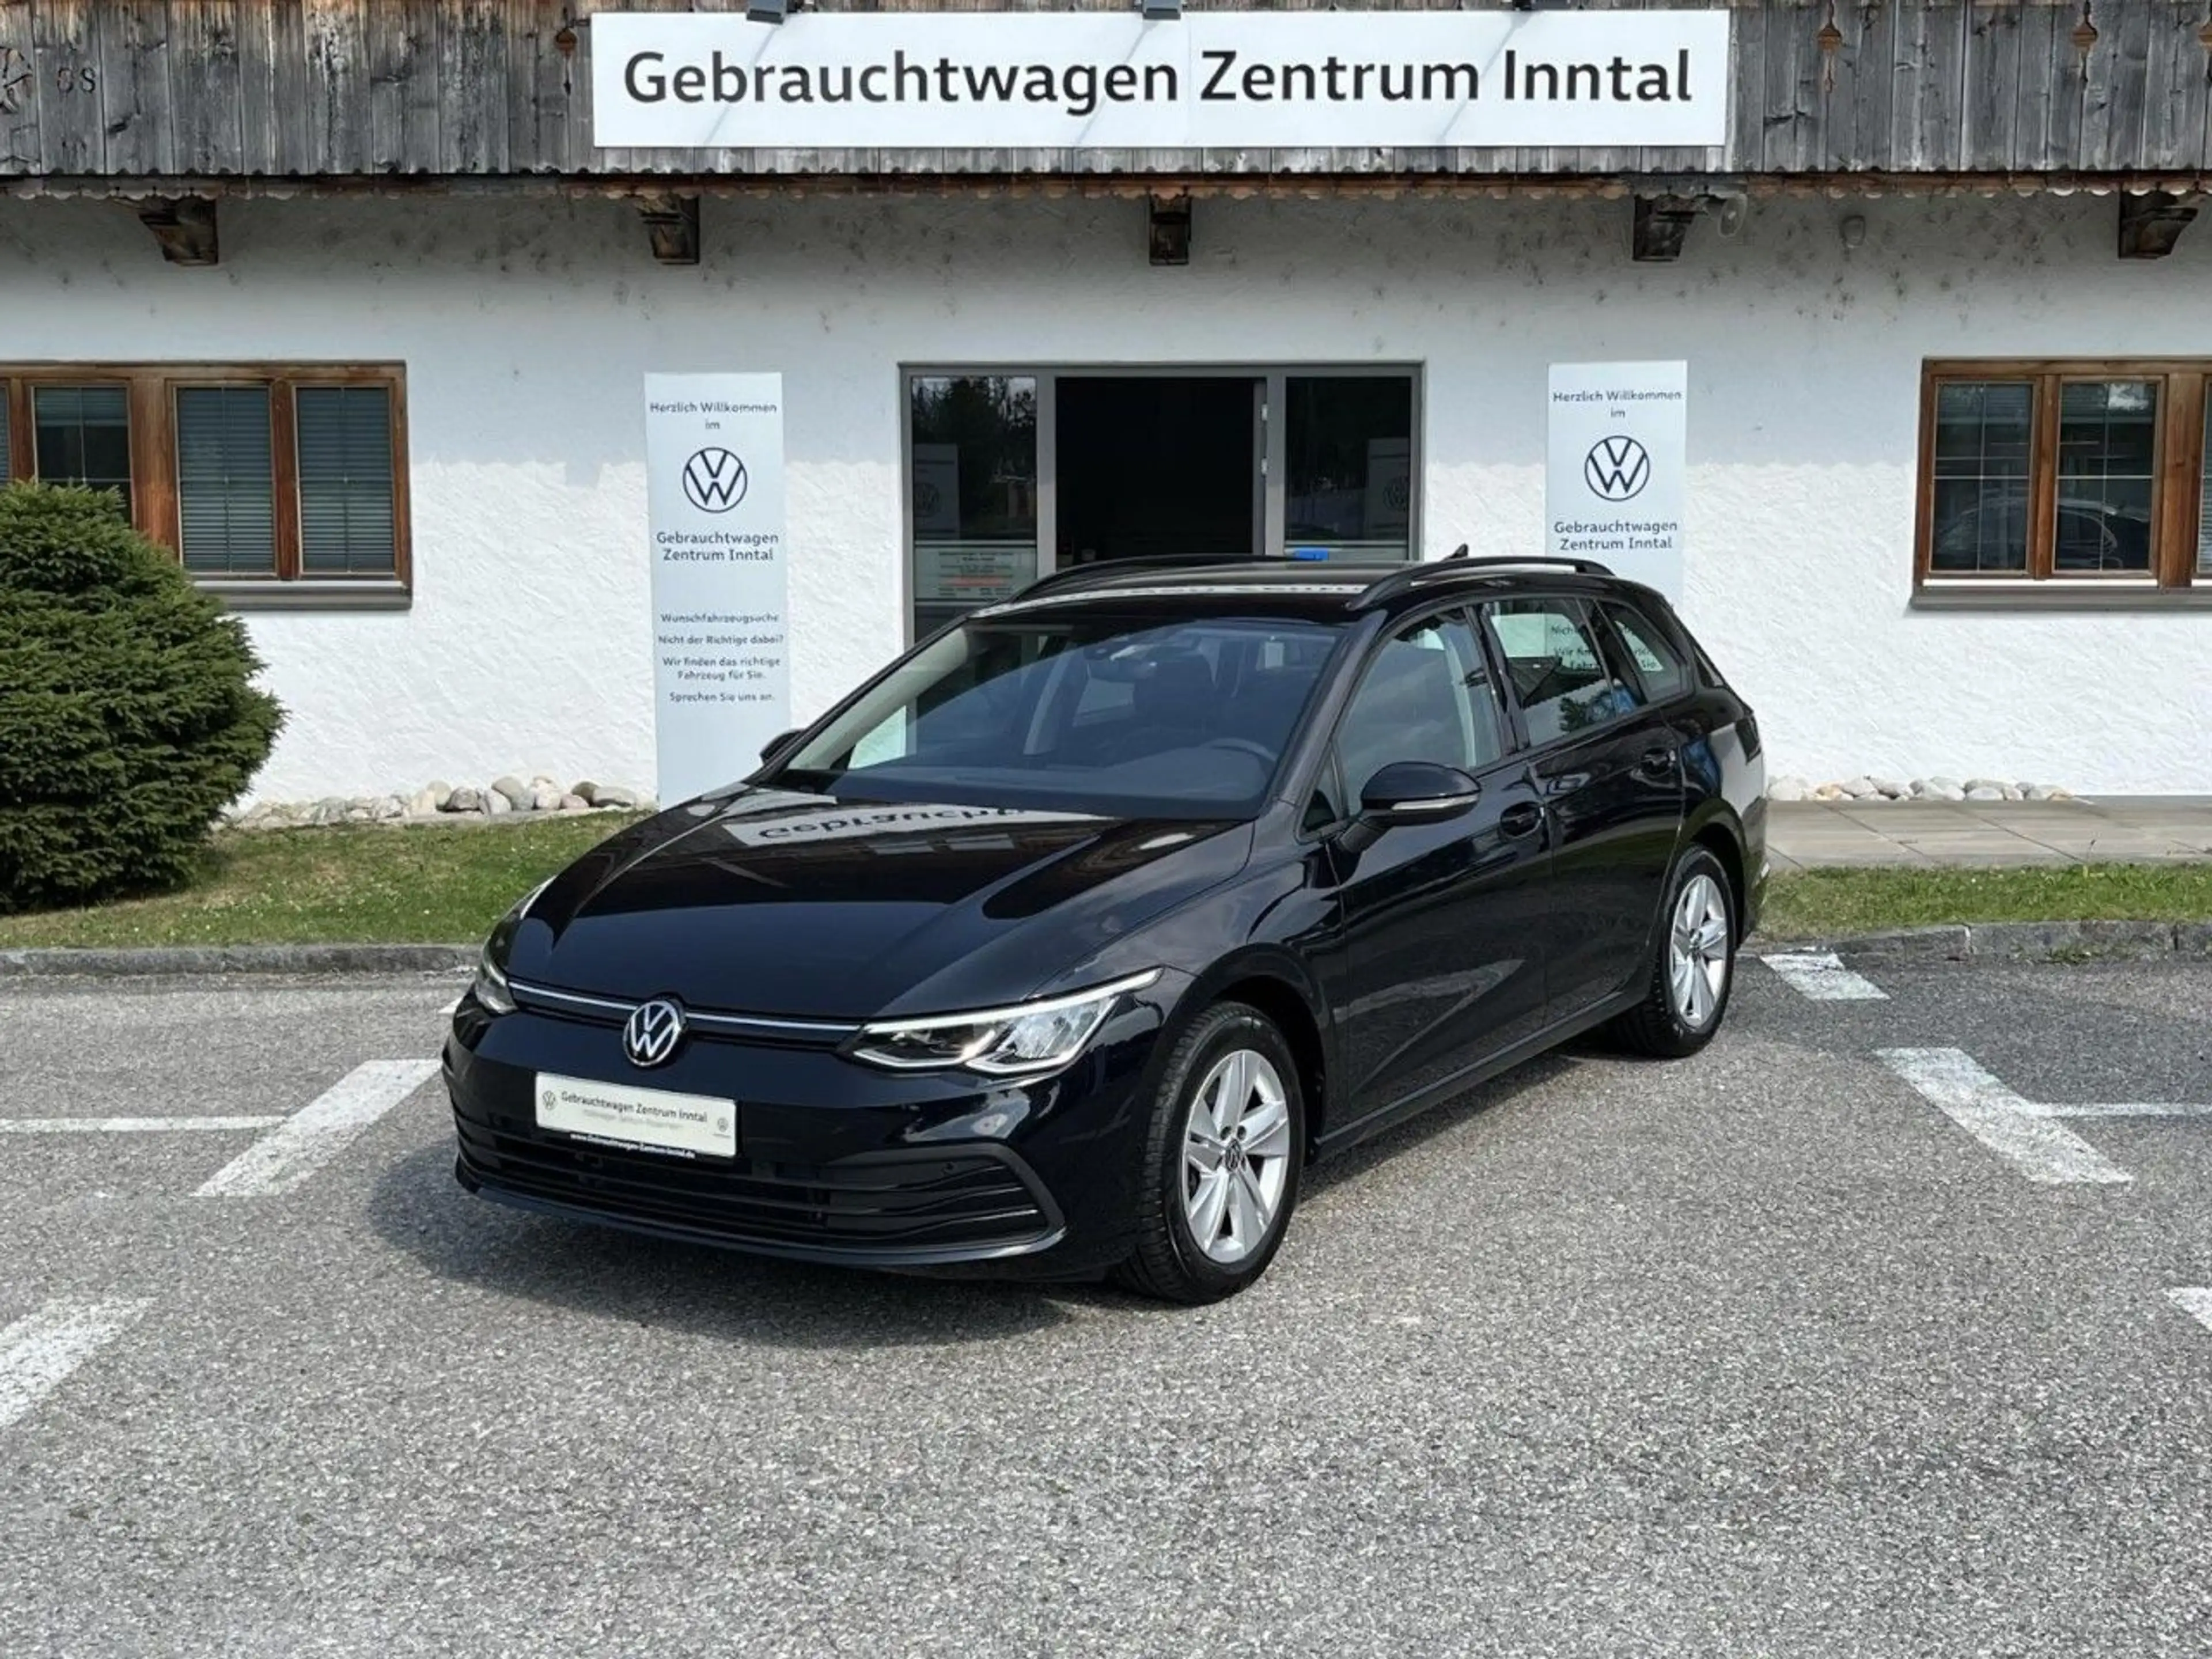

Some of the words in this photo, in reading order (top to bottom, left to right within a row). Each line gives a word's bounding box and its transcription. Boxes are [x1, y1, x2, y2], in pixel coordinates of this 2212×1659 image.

[624, 50, 1177, 117] Gebrauchtwagen
[1200, 50, 1479, 101] Zentrum
[1504, 49, 1692, 101] Inntal
[1553, 390, 1603, 403] Herzlich
[1605, 389, 1681, 402] Willkommen
[649, 402, 698, 414] Herzlich
[699, 402, 778, 414] Willkommen
[1610, 407, 1626, 419] im
[705, 421, 721, 430] im
[1554, 520, 1677, 535] Gebrauchtwagen
[656, 531, 779, 547] Gebrauchtwagen
[1559, 537, 1624, 551] Zentrum
[1628, 536, 1673, 550] Inntal
[663, 548, 725, 562] Zentrum
[729, 548, 774, 562] Inntal
[660, 613, 779, 624] Wunschfahrzeugsuche
[658, 635, 684, 644] Nicht
[687, 635, 703, 644] der
[706, 635, 748, 646] Richtige
[662, 657, 682, 666] Wir
[684, 657, 717, 666] finden
[718, 657, 737, 666] das
[740, 656, 781, 668] richtige
[677, 670, 726, 681] Fahrzeug
[728, 669, 744, 680] für
[669, 691, 718, 703] Sprechen
[719, 692, 736, 702] Sie
[635, 1102, 677, 1119] Zentrum
